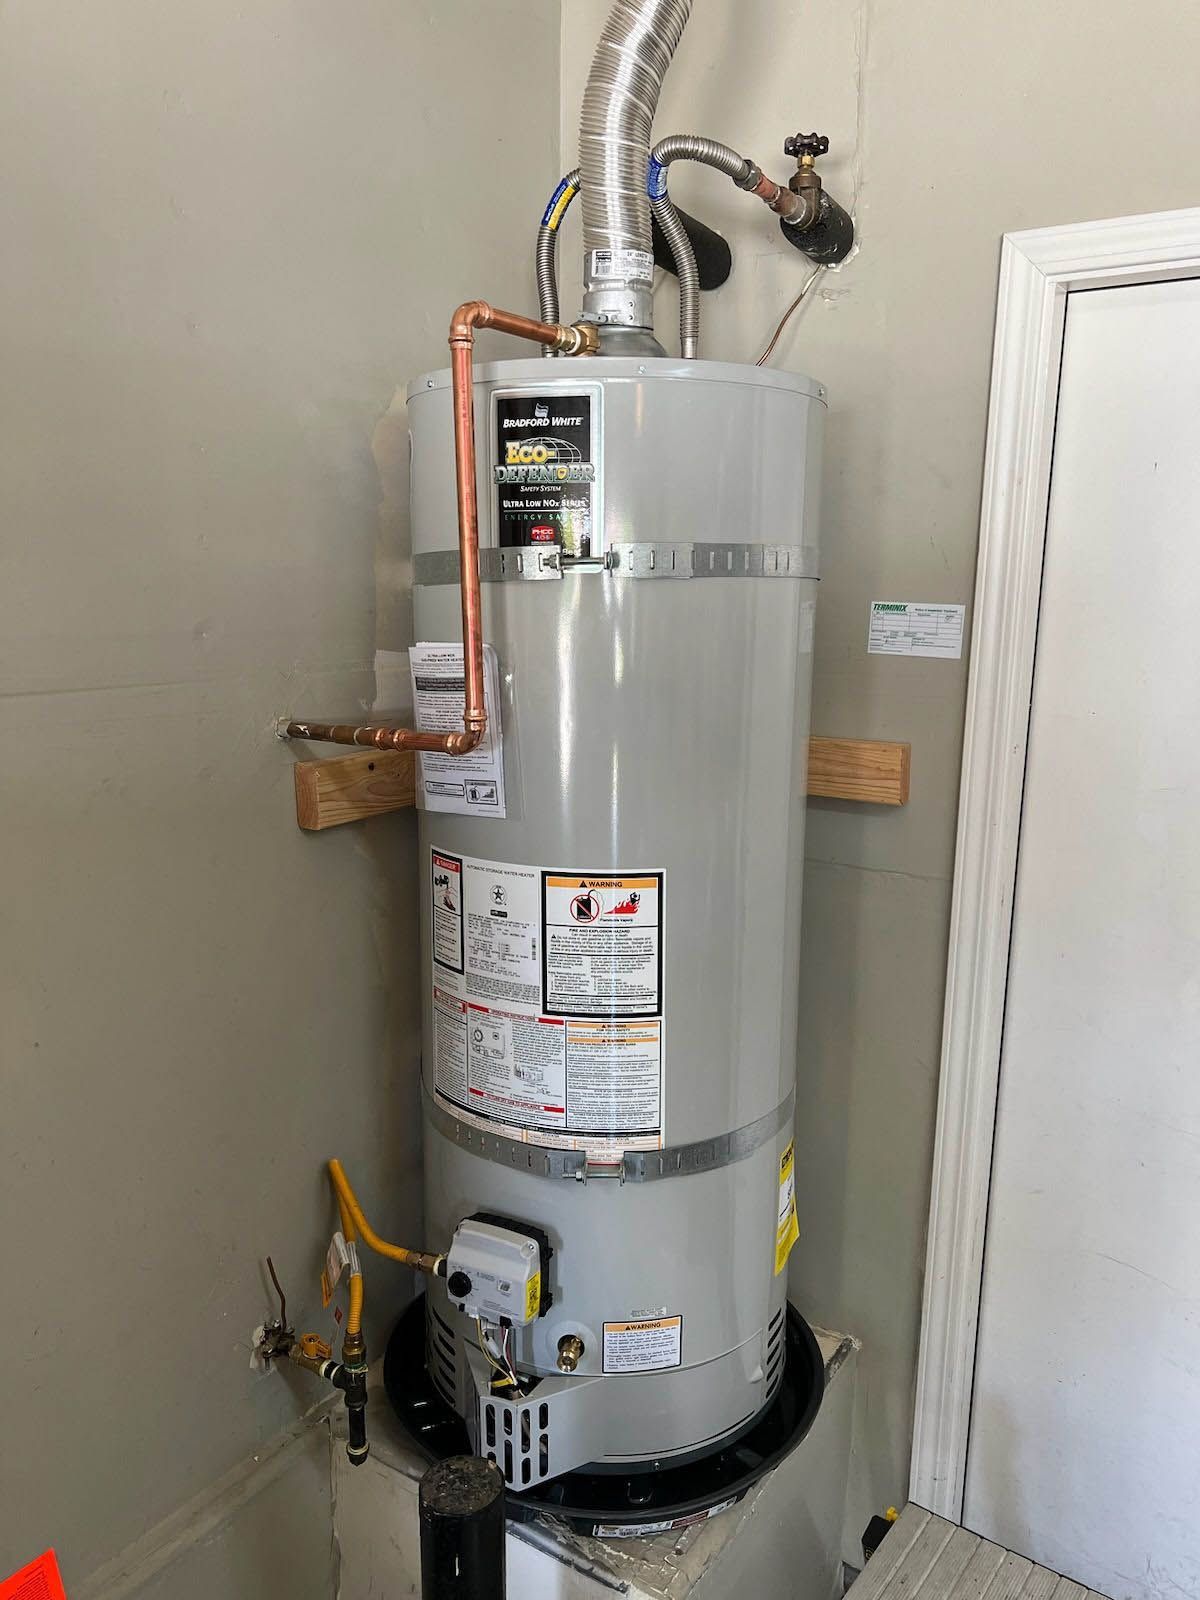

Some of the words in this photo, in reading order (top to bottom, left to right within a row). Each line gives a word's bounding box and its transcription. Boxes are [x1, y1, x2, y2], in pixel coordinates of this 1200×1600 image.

[503, 418, 550, 428] BRADFORD
[551, 417, 582, 427] WHITE
[494, 464, 595, 484] DEFENDER
[520, 485, 540, 493] SAFETY
[503, 499, 524, 508] ULTRA
[525, 499, 541, 508] LOW
[873, 603, 909, 612] TERMINIX
[630, 1322, 661, 1331] WARNING
